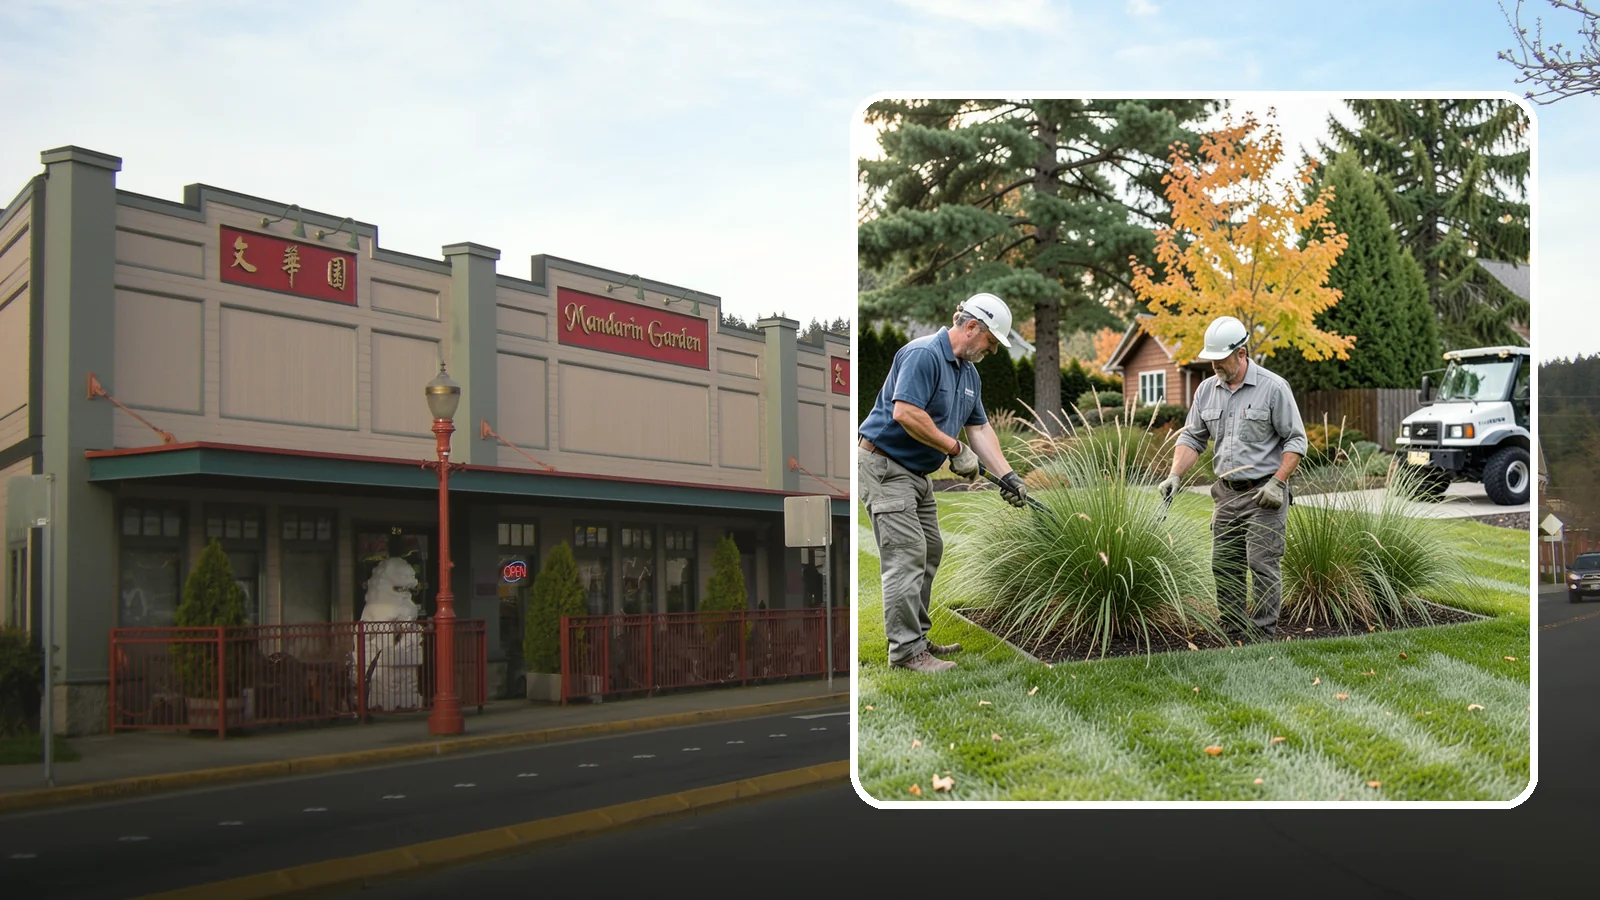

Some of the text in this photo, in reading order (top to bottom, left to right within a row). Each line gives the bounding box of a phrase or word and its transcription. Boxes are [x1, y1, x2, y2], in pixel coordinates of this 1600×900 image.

[230, 235, 346, 291] 文華園
[564, 302, 701, 352] Mandarin Garden
[835, 363, 846, 386] 文
[503, 565, 527, 578] OPEN
